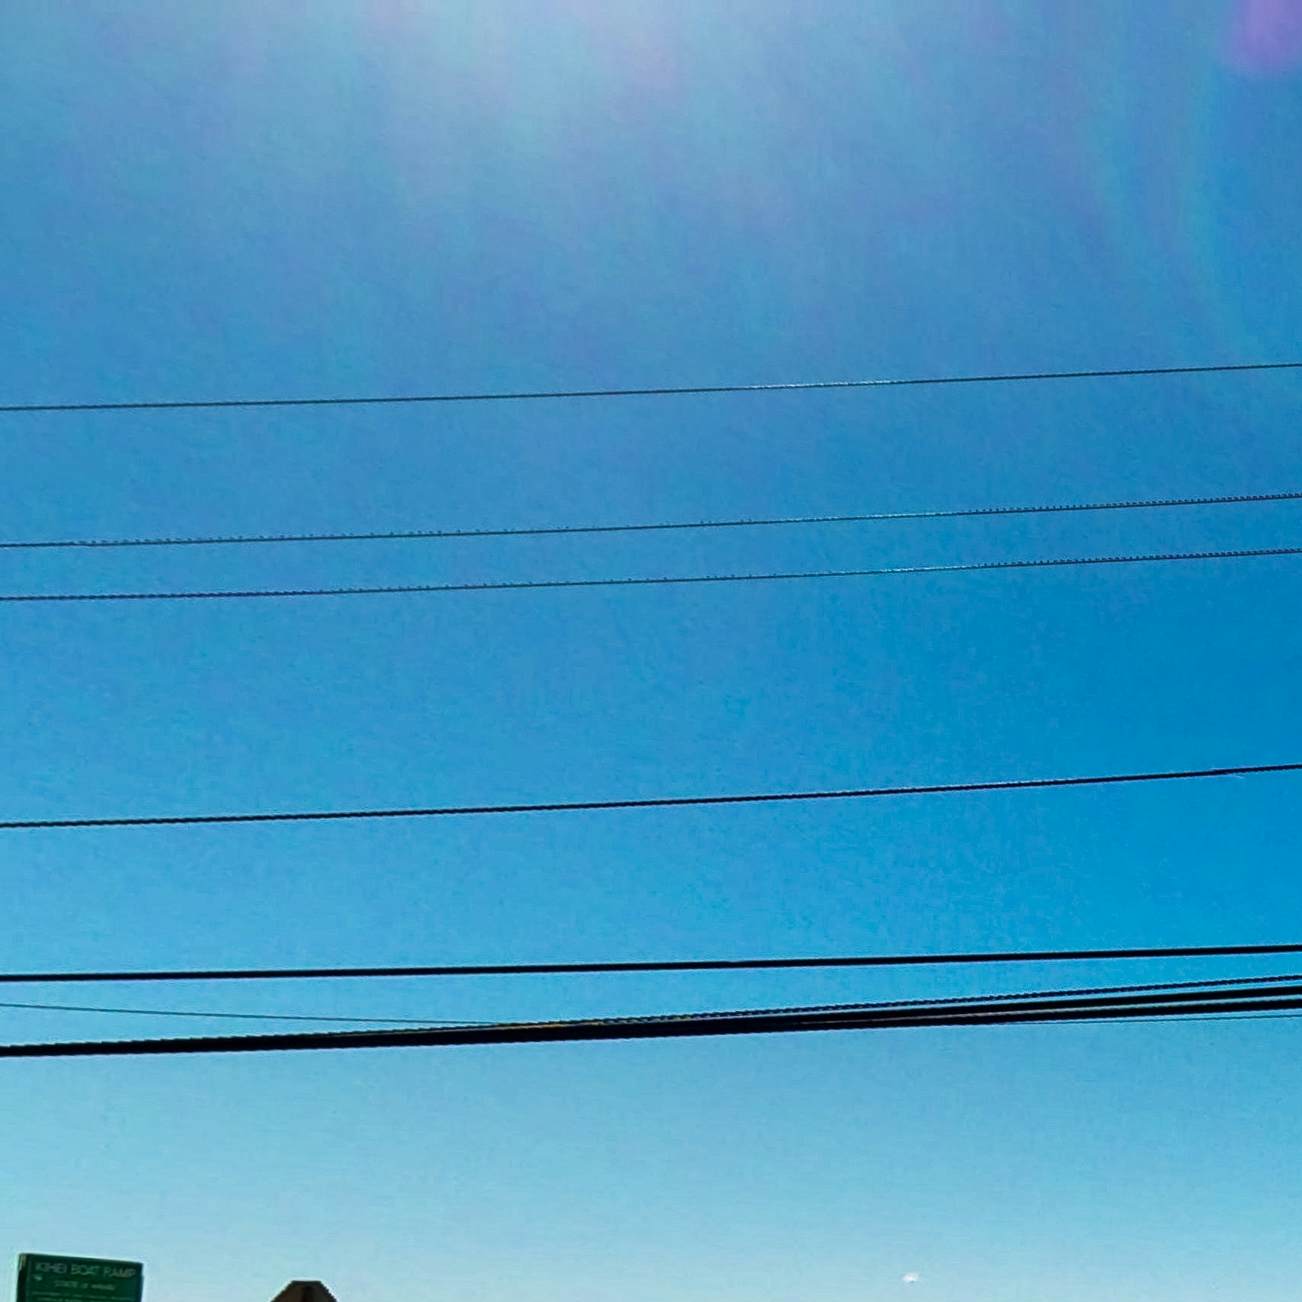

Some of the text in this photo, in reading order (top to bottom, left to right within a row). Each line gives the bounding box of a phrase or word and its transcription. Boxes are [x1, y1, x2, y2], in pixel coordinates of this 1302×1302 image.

[35, 1261, 137, 1279] KIHEI BOAT RAMP
